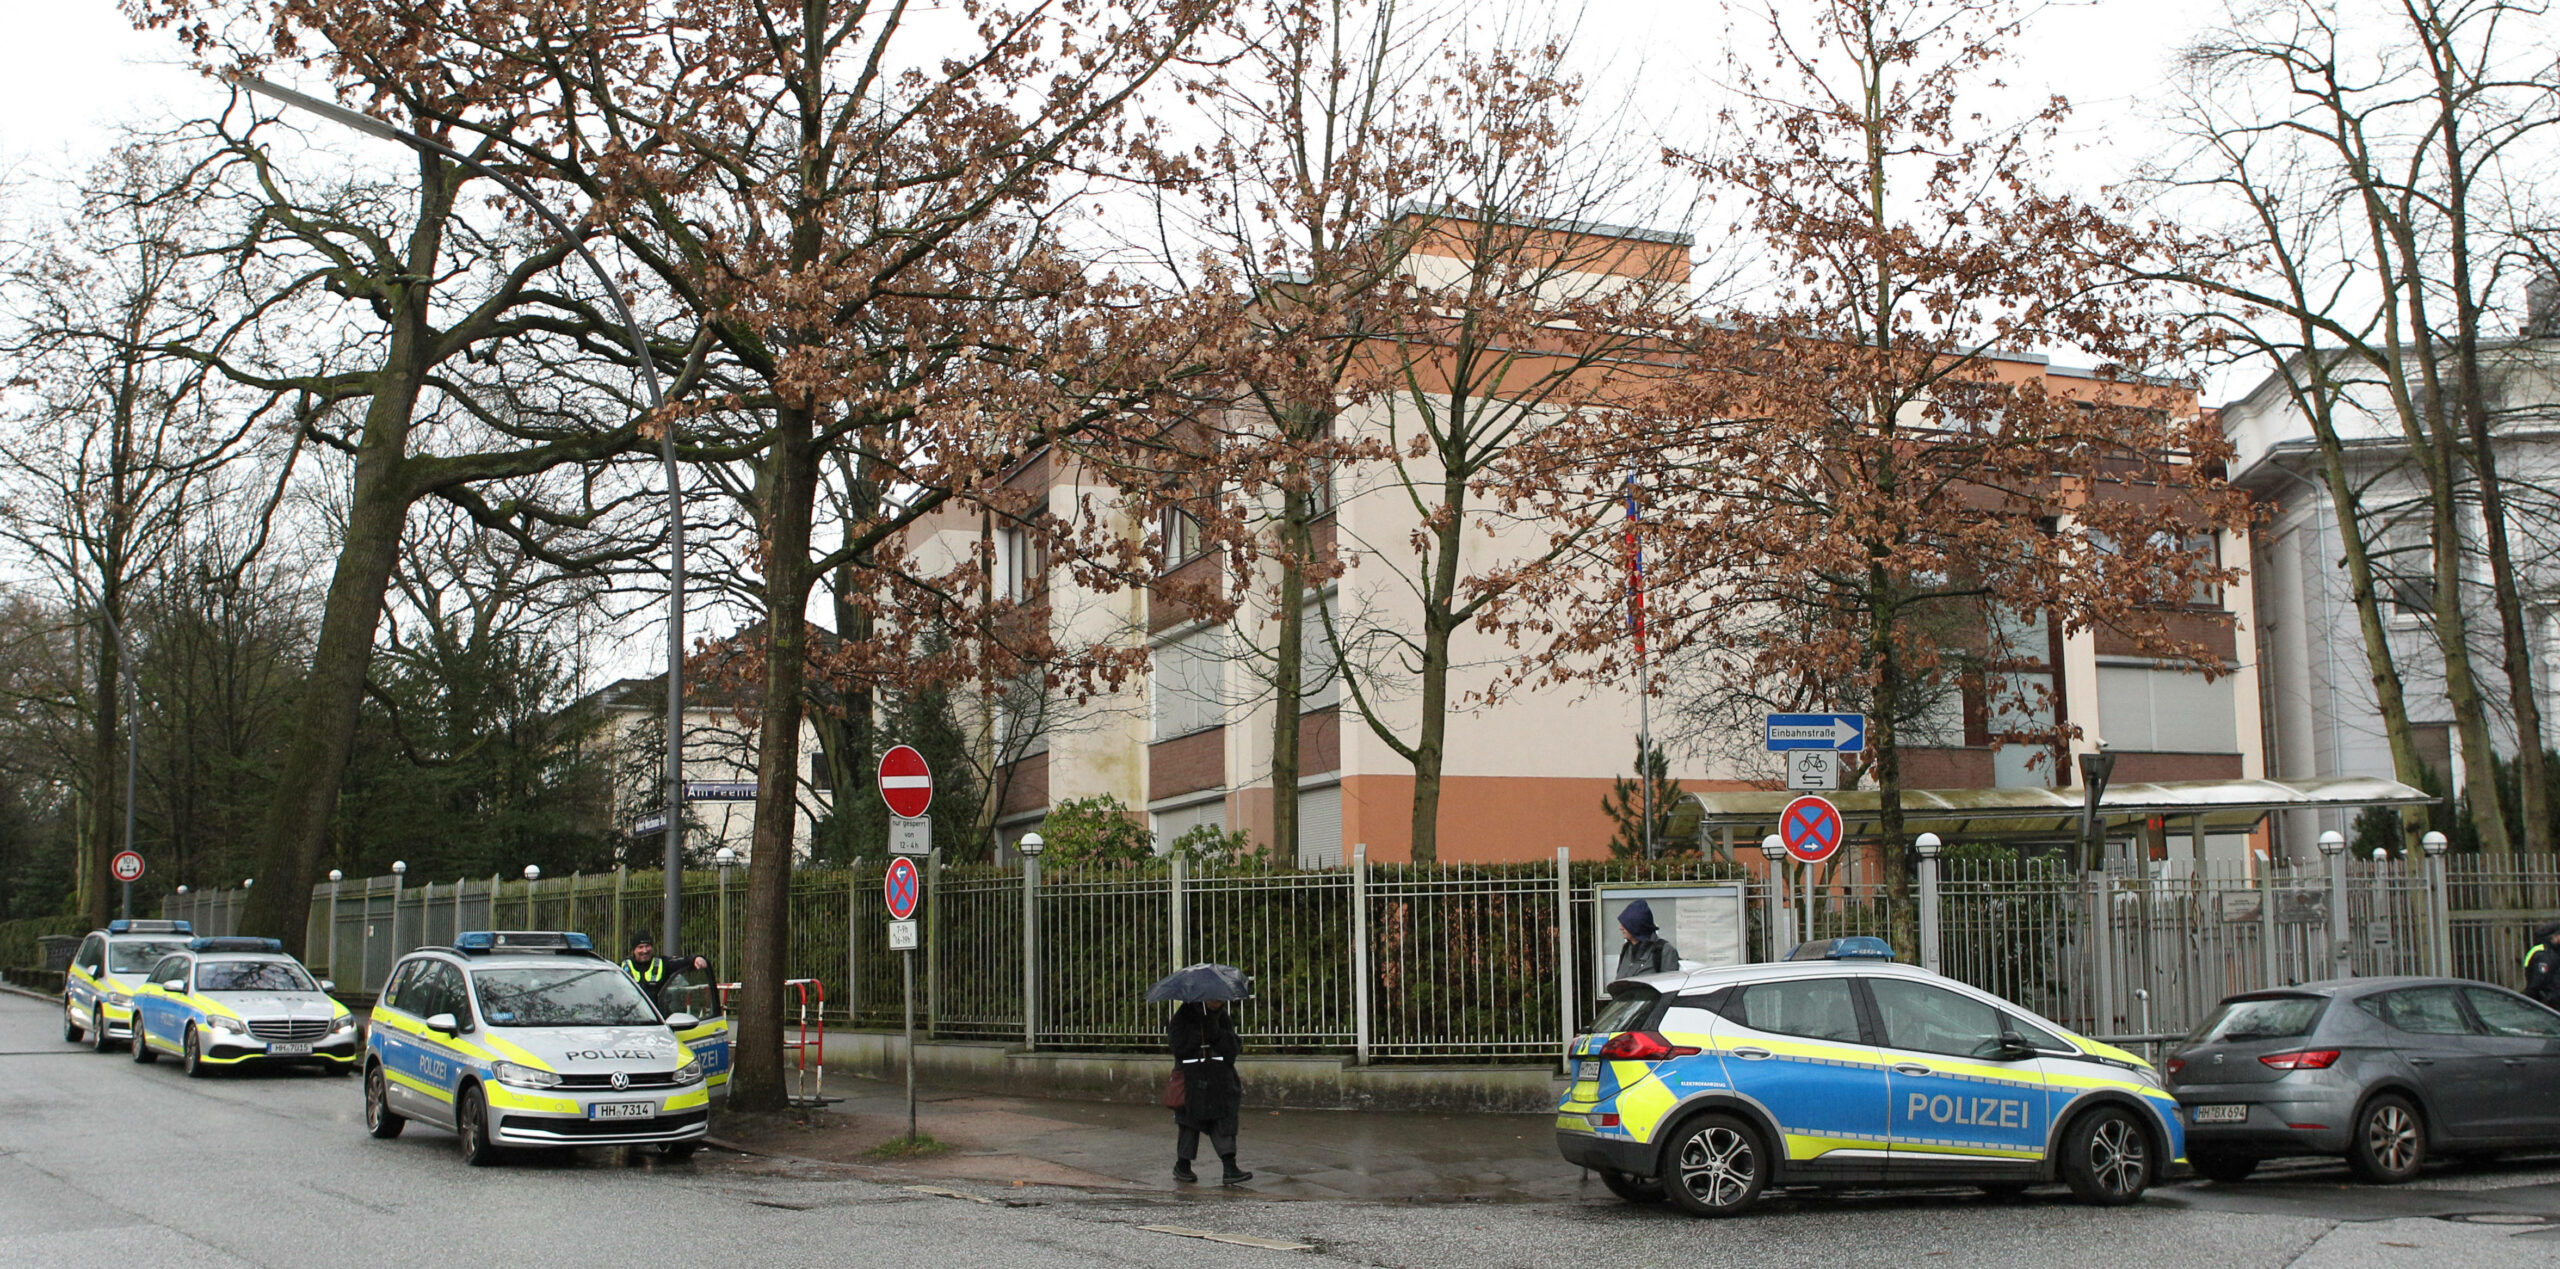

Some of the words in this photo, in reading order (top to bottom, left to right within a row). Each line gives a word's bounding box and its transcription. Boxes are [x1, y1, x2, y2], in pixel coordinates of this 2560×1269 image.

[1771, 728, 1836, 738] Einbahnstraße
[687, 786, 708, 798] Am
[902, 820, 926, 828] gesperrt
[565, 1049, 656, 1061] POLIZEI
[419, 1054, 447, 1080] POLIZEI
[601, 1105, 616, 1117] HH
[622, 1104, 648, 1116] 7314
[1907, 1092, 2029, 1129] POLIZEI
[2198, 1107, 2210, 1119] HH
[2214, 1106, 2226, 1119] BX
[2227, 1105, 2245, 1118] 694
